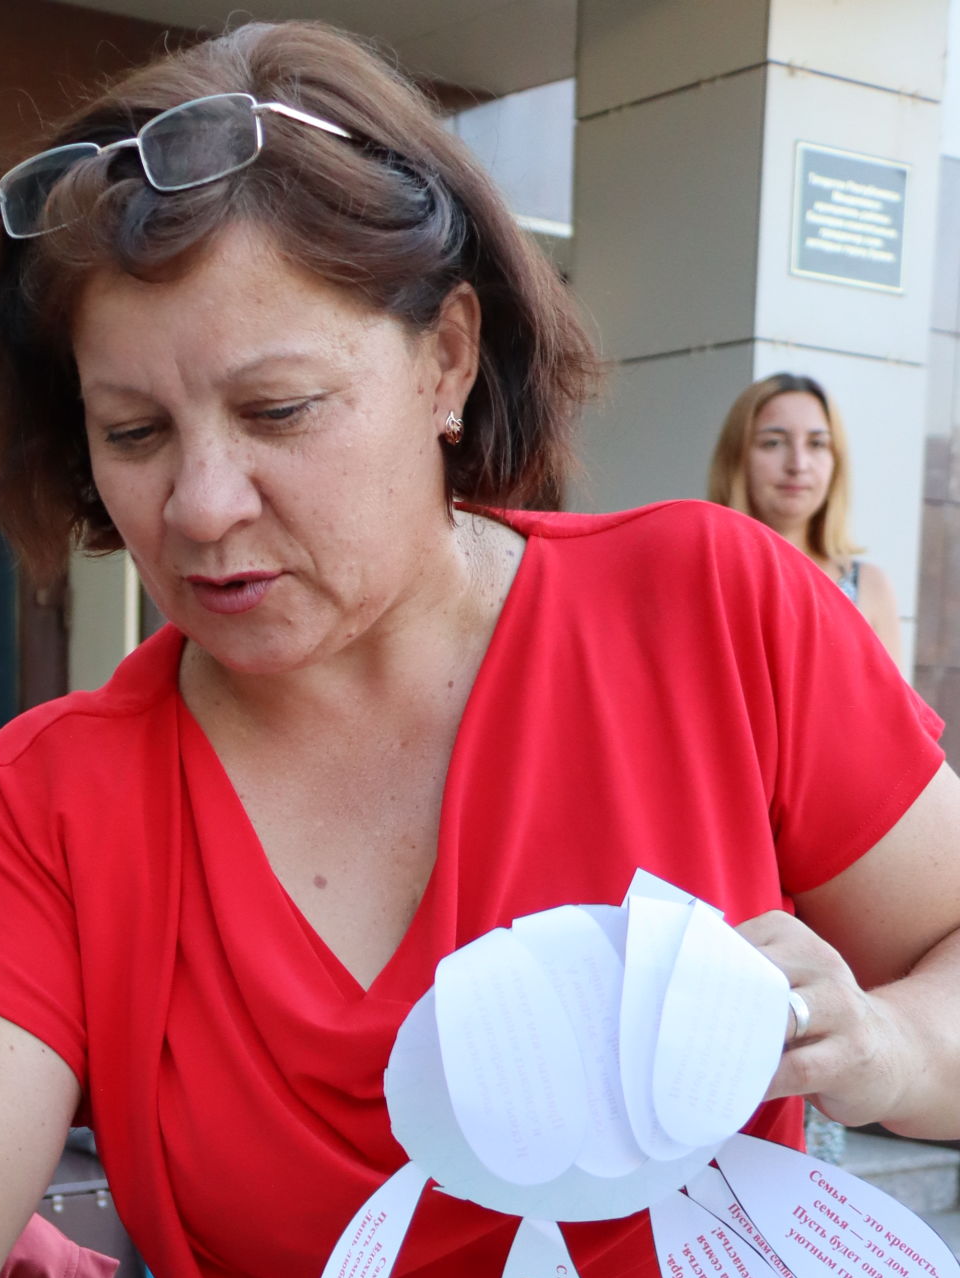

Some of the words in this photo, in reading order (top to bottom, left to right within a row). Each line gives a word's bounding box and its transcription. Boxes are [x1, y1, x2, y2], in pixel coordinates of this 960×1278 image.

[810, 1170, 847, 1204] Семья
[864, 1215, 883, 1232] это
[697, 1235, 722, 1271] семья
[729, 1203, 754, 1234] Пусть
[753, 1233, 771, 1254] вам
[785, 1228, 837, 1269] уютным
[793, 1205, 826, 1238] Пусть
[829, 1235, 860, 1263] будет
[813, 1200, 848, 1229] семья
[865, 1240, 884, 1258] это
[557, 1265, 567, 1274] С
